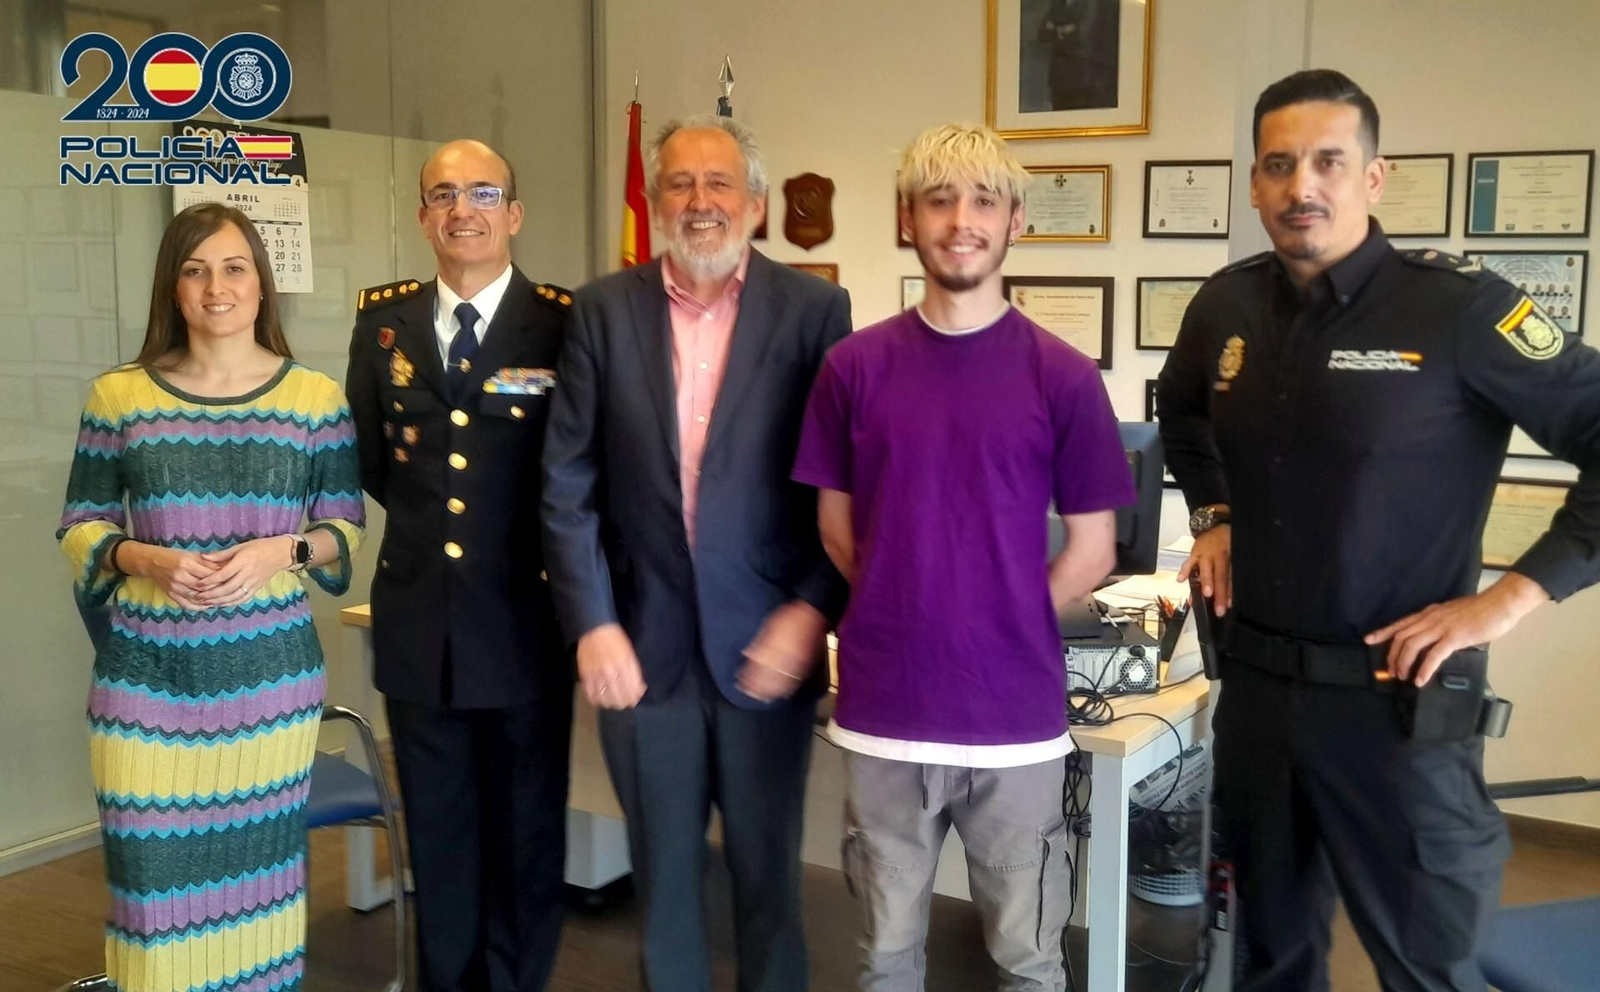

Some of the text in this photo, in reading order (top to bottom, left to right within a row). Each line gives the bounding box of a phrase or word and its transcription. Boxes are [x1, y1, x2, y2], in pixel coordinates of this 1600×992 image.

[226, 193, 260, 203] ABRIL
[260, 226, 297, 236] 5 6 7
[275, 239, 285, 248] 13
[291, 240, 301, 249] 14
[275, 251, 301, 261] 20 21
[275, 263, 302, 273] 27 28
